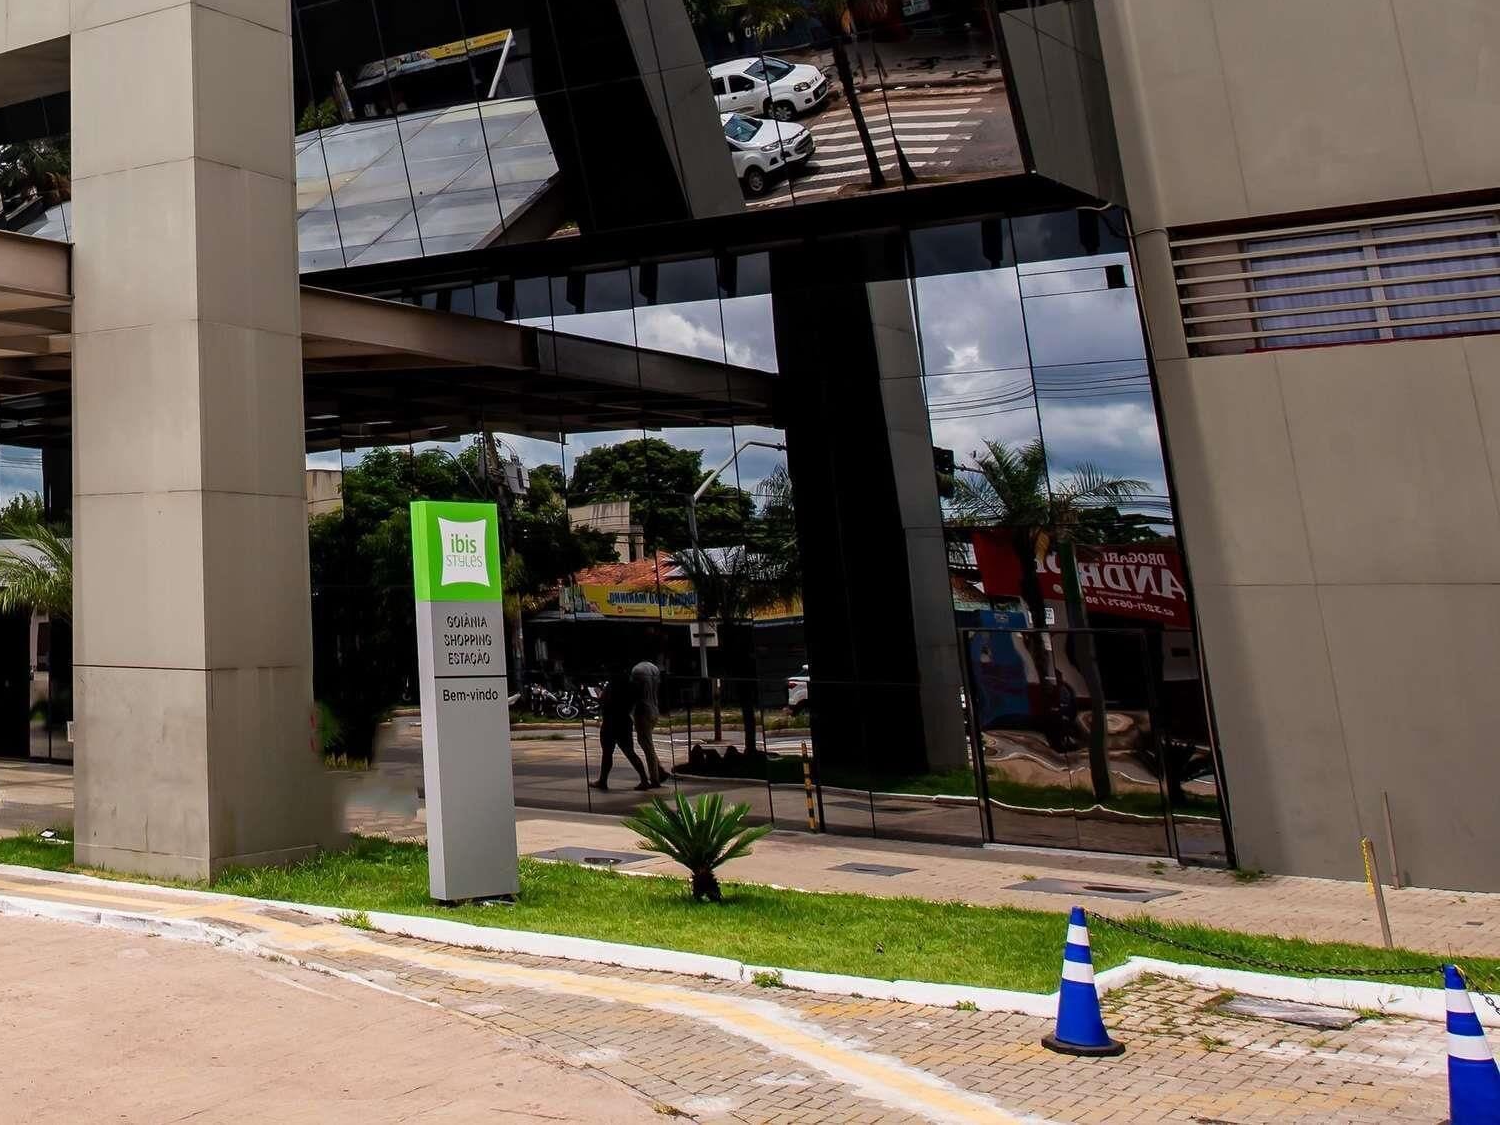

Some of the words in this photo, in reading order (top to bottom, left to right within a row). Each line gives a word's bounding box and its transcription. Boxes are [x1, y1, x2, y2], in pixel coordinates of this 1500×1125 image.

[450, 533, 477, 554] ibis
[446, 612, 488, 628] GOIÂNIA
[443, 634, 493, 648] SHOPPING
[448, 649, 491, 667] ESTAÇÃO
[443, 688, 498, 702] Bem-vindo
